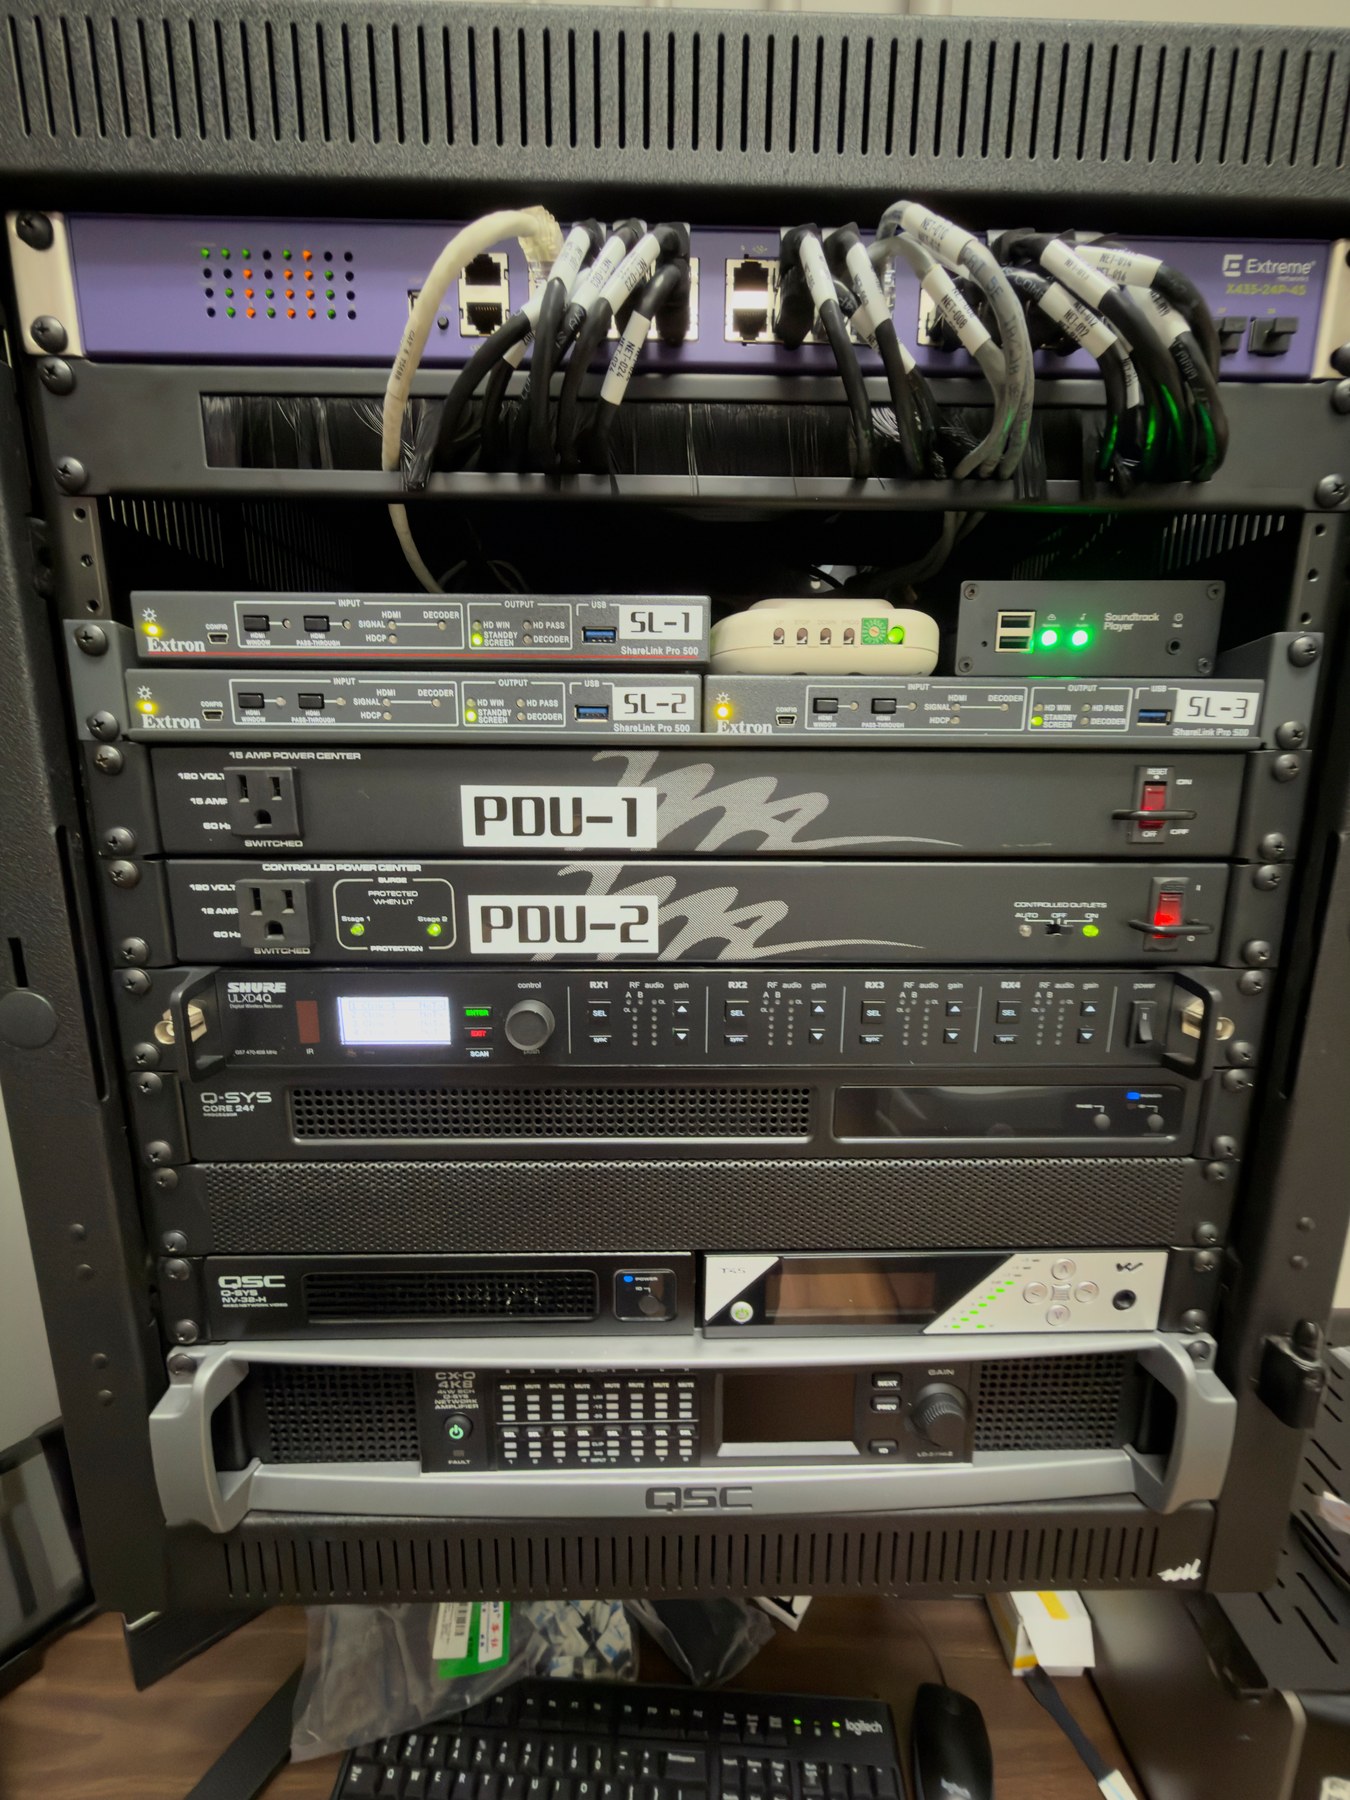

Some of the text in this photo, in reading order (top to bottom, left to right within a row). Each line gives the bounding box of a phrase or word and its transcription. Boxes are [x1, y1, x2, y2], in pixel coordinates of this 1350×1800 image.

[1245, 258, 1309, 274] Extreme
[616, 341, 636, 378] NET-024
[338, 599, 361, 608] INPUT
[504, 601, 534, 609] OUTPUT
[591, 601, 607, 609] USB
[382, 611, 401, 619] HDMI
[423, 611, 460, 620] DECODER
[1104, 612, 1160, 622] Soundtrack
[358, 620, 386, 629] SIGNAL
[483, 621, 510, 629] HD WIN
[533, 621, 565, 629] HD PASS
[630, 612, 690, 633] SL-1
[1103, 621, 1134, 632] Player
[365, 635, 387, 643] HDCP
[484, 631, 518, 640] STANDBY
[533, 635, 570, 644] DECODER
[146, 636, 206, 653] Extron
[484, 639, 514, 647] SCREEN
[621, 646, 699, 656] ShareLink Pro 500
[333, 677, 356, 686] INPUT
[498, 679, 529, 687] OUTPUT
[584, 680, 600, 688] USB
[907, 683, 930, 691] INPUT
[376, 688, 396, 697] HDMI
[417, 689, 454, 698] DECODER
[353, 698, 381, 706] SIGNAL
[988, 694, 1024, 702] DECODER
[477, 699, 504, 707] HD WIN
[526, 699, 559, 708] HD PASS
[624, 693, 687, 714] SL-2
[924, 703, 951, 711] SIGNAL
[1188, 696, 1250, 719] SL-3
[1056, 704, 1071, 712] WIN
[1092, 704, 1124, 712] HD PASS
[360, 711, 382, 720] HDCP
[477, 709, 512, 717] STANDBY
[527, 712, 563, 721] DECODER
[1043, 713, 1077, 722] STANDBY
[141, 713, 201, 729] Extron
[478, 716, 508, 724] SCREEN
[929, 717, 950, 725] HDCP
[1090, 717, 1127, 726] DECODER
[613, 723, 690, 733] ShareLink Pro 500
[716, 719, 773, 735] Extron
[1042, 721, 1073, 729] SCREEN
[1172, 728, 1250, 737] ShareLink Pro 500
[229, 752, 361, 761] 15 AMP POWER CENTER
[199, 772, 225, 781] VOLT
[474, 796, 637, 837] PDU-1
[244, 840, 303, 848] SWITCHED
[262, 864, 421, 872] CONTROLLED POWER CENTER
[368, 890, 418, 898] PROTECTED
[480, 905, 649, 943] PDU-2
[254, 947, 310, 955] SWITCHED
[227, 982, 287, 993] SHURE
[518, 981, 542, 989] control
[589, 981, 609, 989] RX1
[645, 982, 665, 990] audio
[674, 982, 689, 991] gain
[728, 981, 748, 989] RX2
[782, 982, 802, 990] audio
[811, 982, 827, 991] gain
[865, 981, 885, 989] RX3
[919, 982, 939, 990] audio
[948, 982, 963, 991] gain
[1001, 981, 1021, 989] RX4
[1055, 982, 1075, 990] audio
[1082, 982, 1099, 991] gain
[227, 993, 272, 1003] ULXD4Q
[592, 1009, 607, 1017] SEL
[730, 1009, 745, 1017] SEL
[866, 1009, 881, 1017] SEL
[1002, 1009, 1016, 1017] SEL
[200, 1091, 272, 1104] Q-SYS
[218, 1275, 286, 1289] QSC
[435, 1371, 476, 1380] CX-Q
[438, 1380, 473, 1389] 4K8
[645, 1487, 752, 1512] QSC
[845, 1718, 883, 1735] logitech
